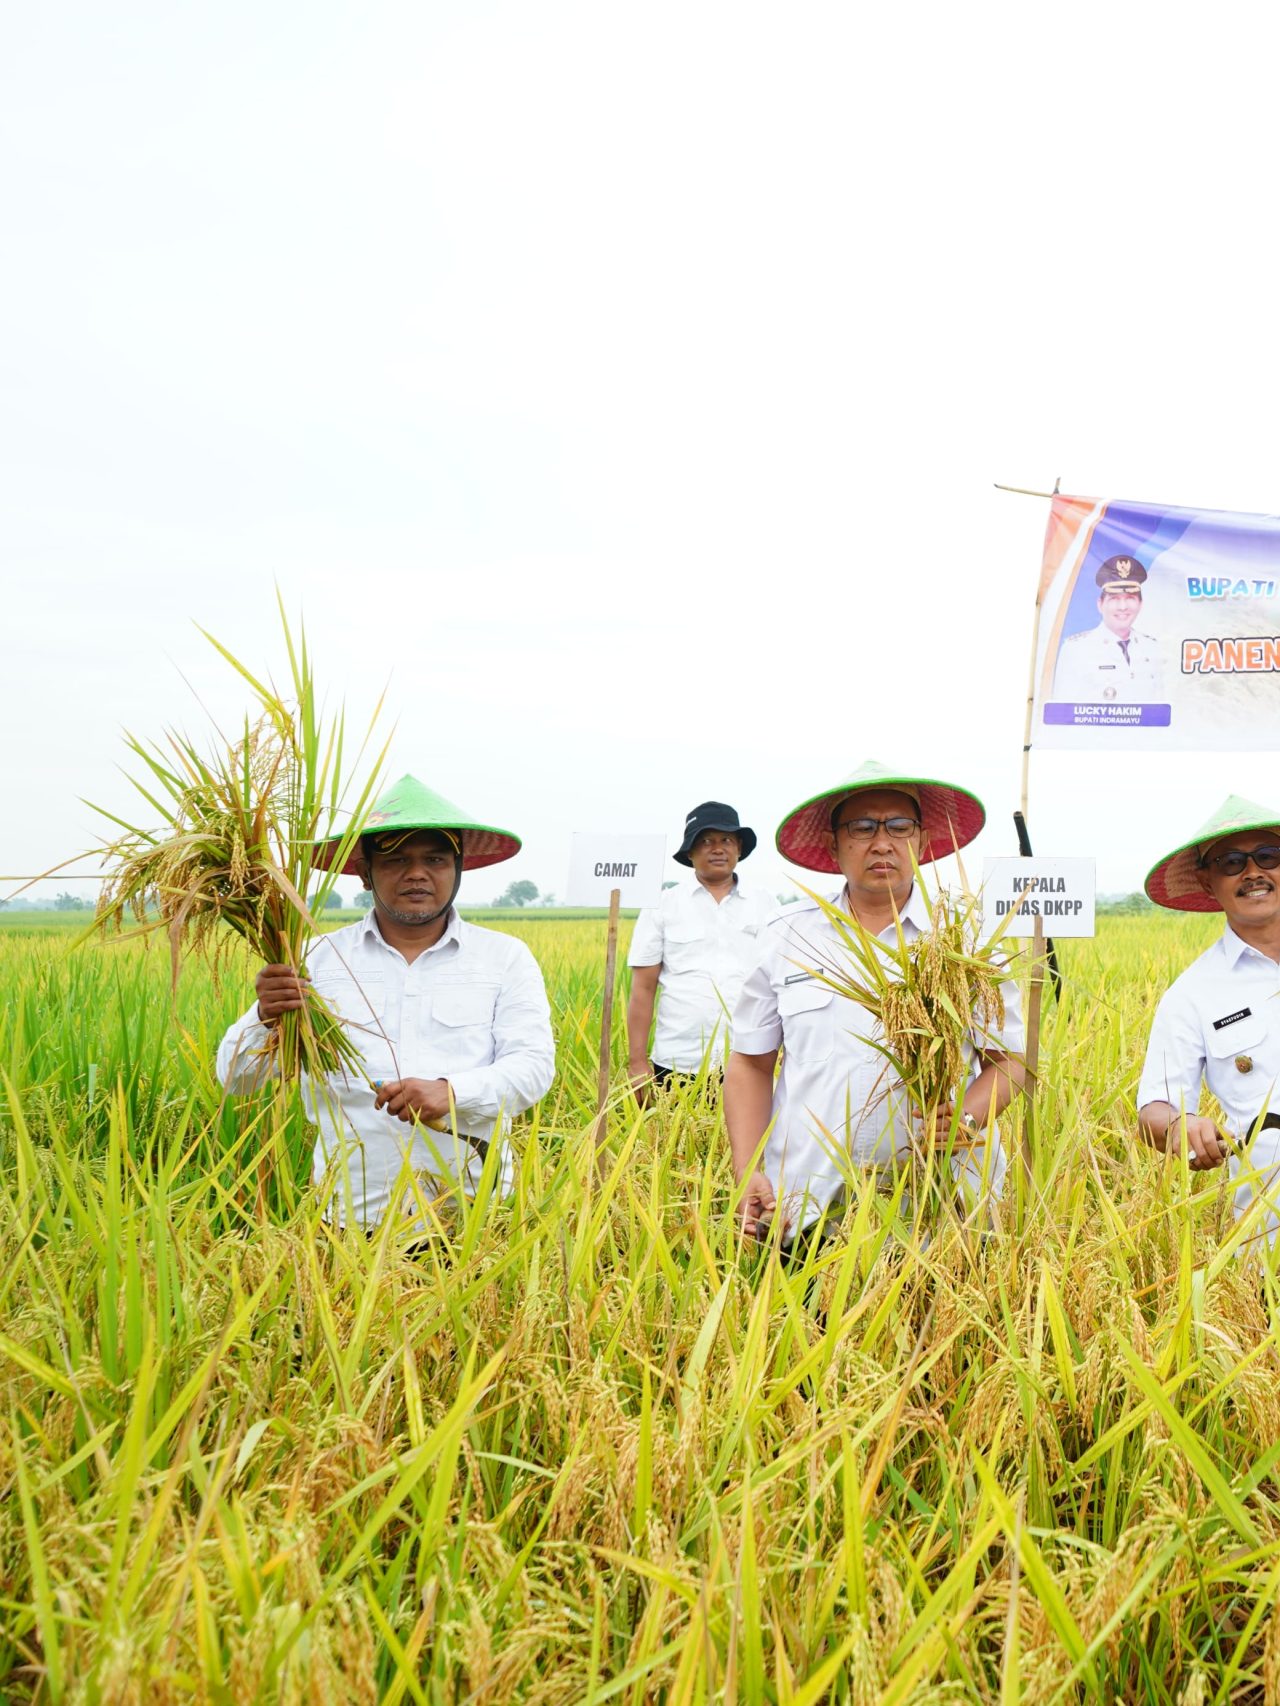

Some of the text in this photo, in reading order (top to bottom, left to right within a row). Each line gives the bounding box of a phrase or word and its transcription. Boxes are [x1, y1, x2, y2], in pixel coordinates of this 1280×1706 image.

[1187, 577, 1274, 597] BUPATI
[1074, 706, 1142, 716] LUCKY HAKIM
[594, 862, 638, 877] CAMAT
[1044, 900, 1083, 916] DKPP
